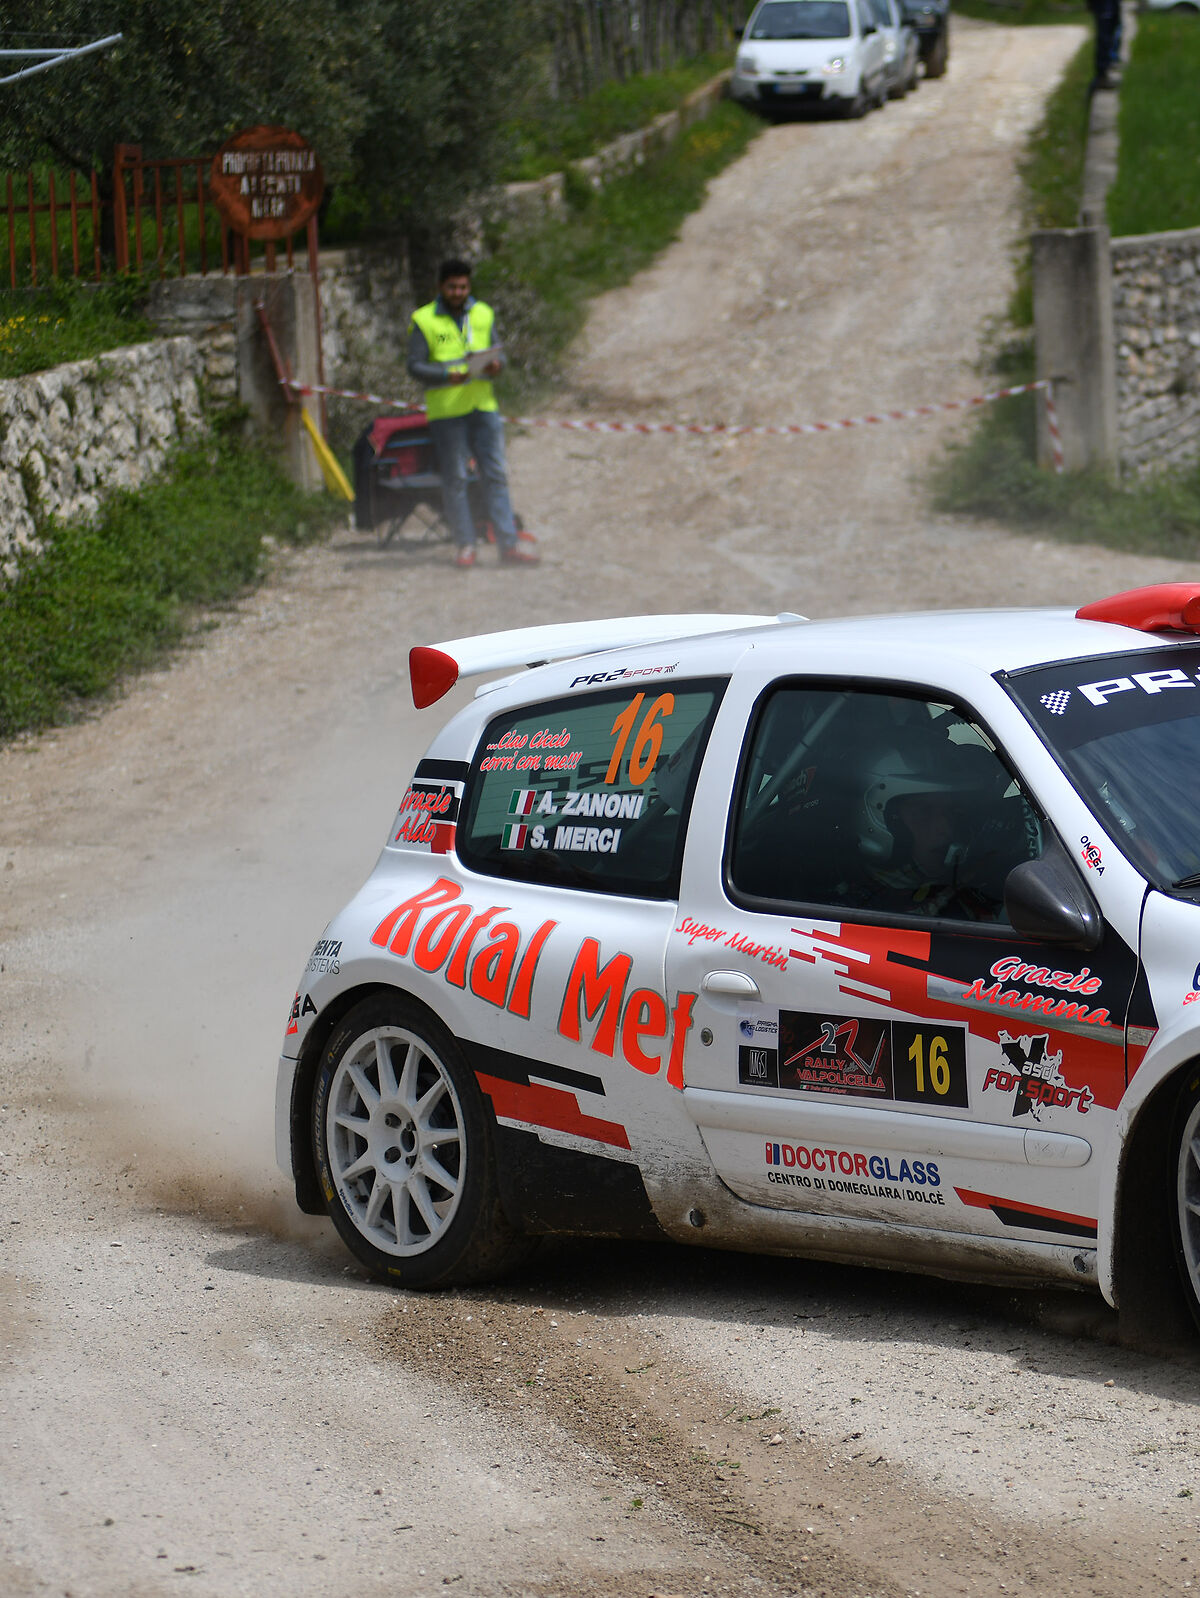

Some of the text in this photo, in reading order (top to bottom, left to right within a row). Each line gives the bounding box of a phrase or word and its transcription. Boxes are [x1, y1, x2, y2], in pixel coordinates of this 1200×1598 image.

[531, 728, 571, 749] Ciccio
[603, 692, 676, 786] 16
[479, 751, 583, 772] corri con me!!!
[535, 790, 645, 820] A. ZANONI
[394, 812, 437, 843] Aldo
[530, 824, 622, 854] S. MERCI
[1080, 835, 1106, 877] OMEGA
[675, 916, 792, 972] Super Martin
[370, 876, 700, 1092] Rotal Met
[988, 955, 1104, 996] Grazie
[962, 978, 1113, 1029] Mamma
[796, 1067, 886, 1089] VALPOLICELLA
[804, 1056, 846, 1071] RALLY
[907, 1033, 952, 1097] 16
[1025, 1079, 1094, 1114] sport
[767, 1171, 813, 1190] CENTRO
[813, 1178, 827, 1190] DI
[781, 1142, 941, 1187] DOCTORGLASS
